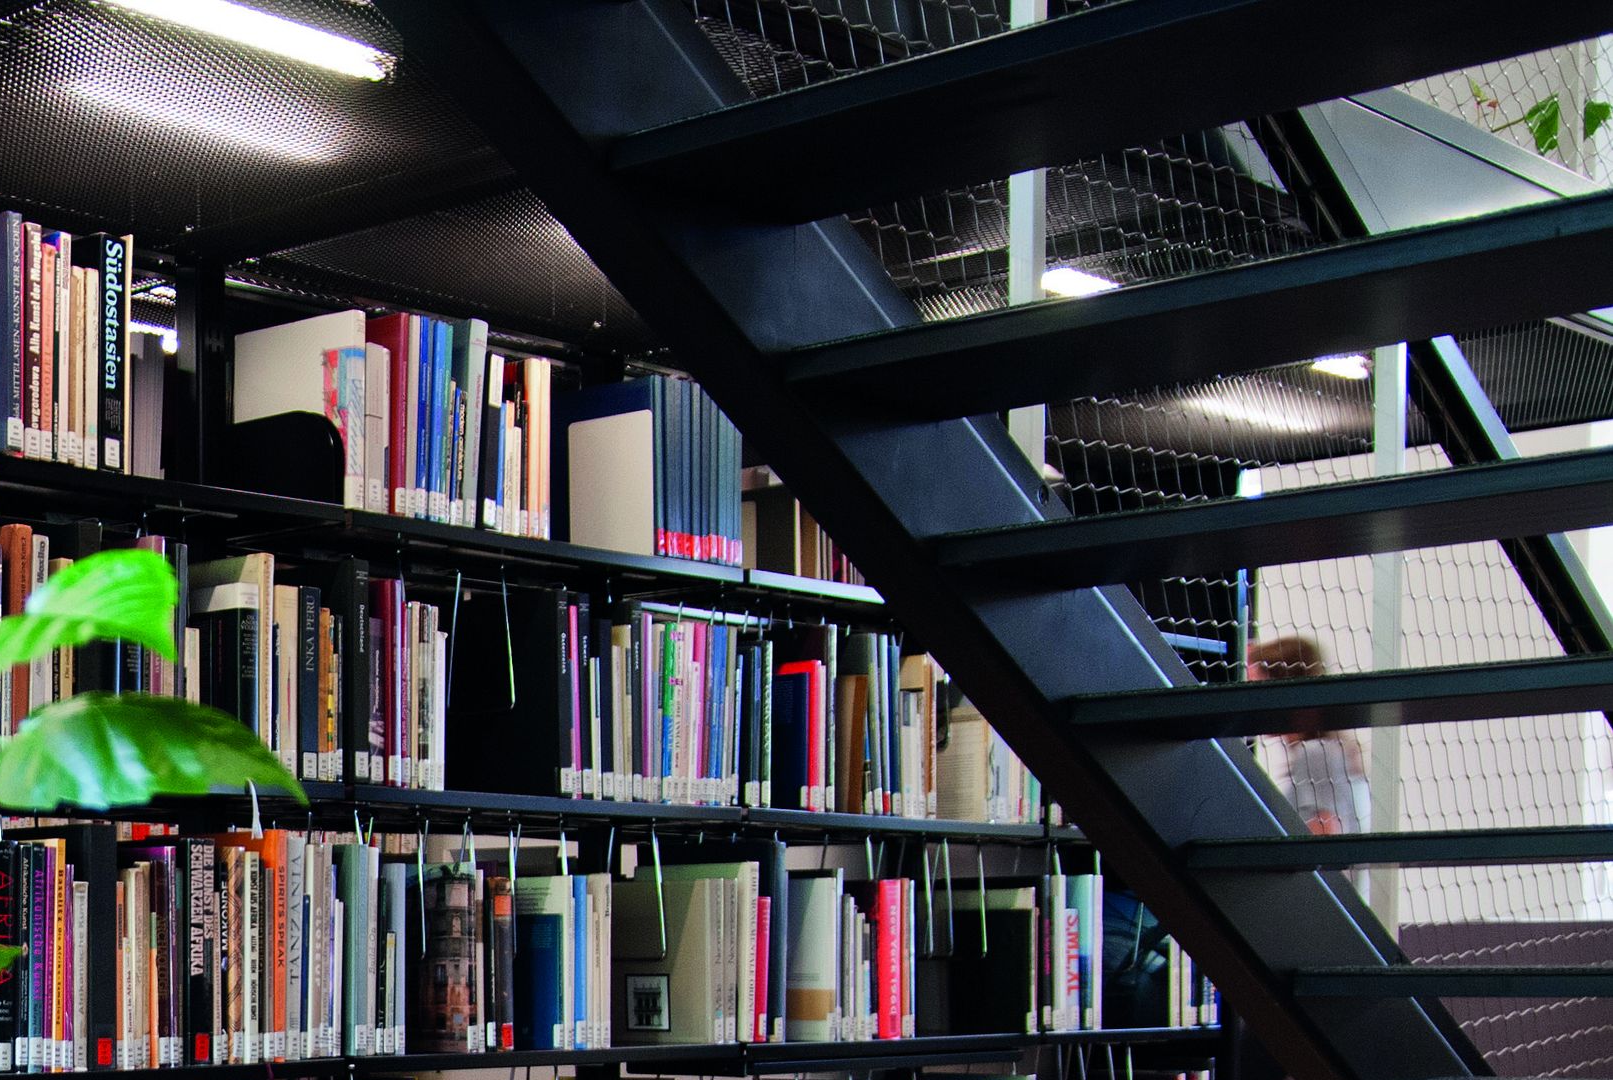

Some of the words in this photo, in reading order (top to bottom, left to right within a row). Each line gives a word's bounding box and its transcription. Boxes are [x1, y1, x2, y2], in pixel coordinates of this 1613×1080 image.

[12, 265, 21, 286] DER
[29, 283, 39, 299] der
[12, 288, 21, 324] KUNST
[104, 239, 124, 389] Südostasien
[30, 366, 41, 429] owgorodowa
[305, 594, 316, 631] PERU
[305, 636, 316, 672] INKA
[203, 844, 214, 866] DIE
[190, 844, 203, 924] SCHWARZEN
[203, 870, 214, 912] KUNST
[277, 865, 285, 918] SPIRITS
[203, 913, 214, 939] DES
[289, 855, 302, 985] TANZANIA
[191, 926, 203, 976] AFRIKA
[277, 922, 285, 968] SPEAK
